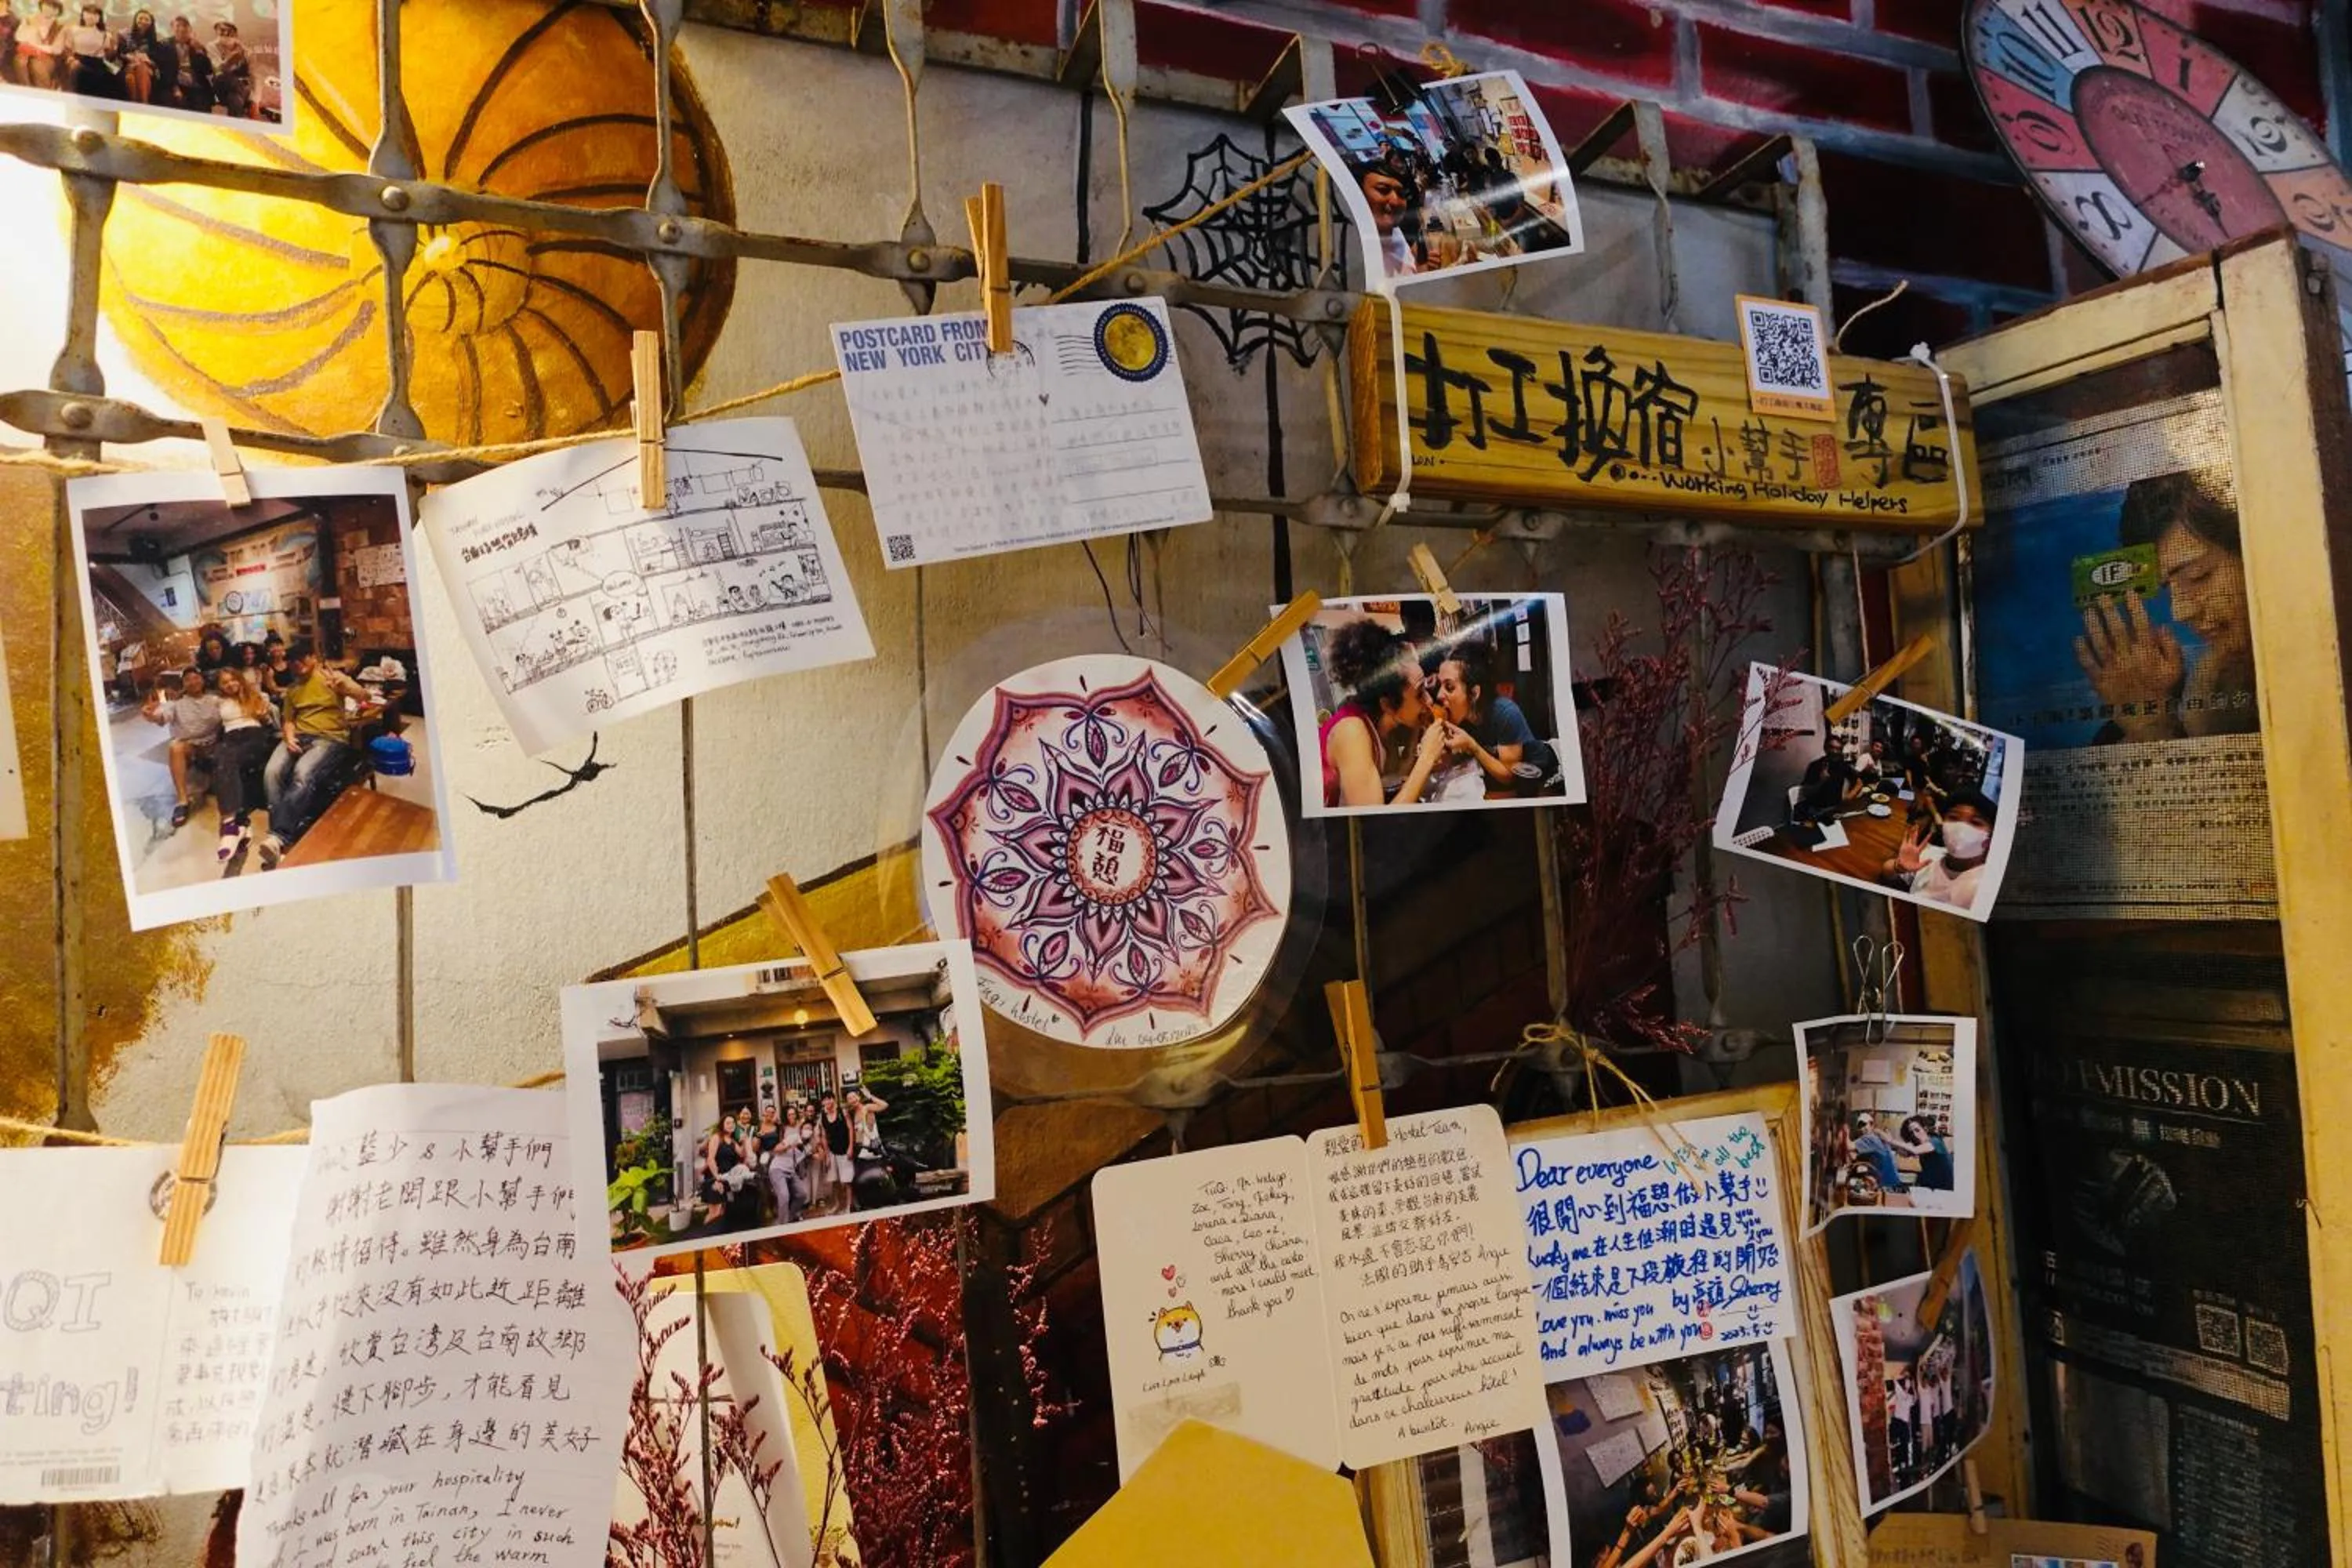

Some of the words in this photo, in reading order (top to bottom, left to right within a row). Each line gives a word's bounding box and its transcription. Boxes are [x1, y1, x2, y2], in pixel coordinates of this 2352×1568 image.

[840, 324, 936, 351] POSTCARD
[941, 319, 989, 342] FROM
[844, 350, 887, 372] NEW
[897, 345, 946, 367] YORK
[1659, 472, 1748, 499] Working
[1753, 481, 1829, 509] Holiday
[1838, 492, 1908, 514] Helpers
[1516, 1147, 1573, 1192] Dear
[1576, 1154, 1660, 1188] everyone
[1528, 1240, 1570, 1272] Lucky
[2, 1269, 112, 1334] QI
[1226, 1296, 1261, 1320] thank
[1264, 1295, 1283, 1318] you
[1603, 1302, 1630, 1322] miss
[1633, 1305, 1654, 1327] you
[1672, 1290, 1690, 1316] by
[1541, 1338, 1568, 1360] And
[1577, 1332, 1624, 1365] always
[1630, 1332, 1646, 1350] be
[1650, 1323, 1676, 1345] with
[0, 1366, 140, 1436] ting!
[433, 1465, 525, 1502] hospitality
[518, 1504, 572, 1520] never
[495, 1548, 550, 1565] warm
